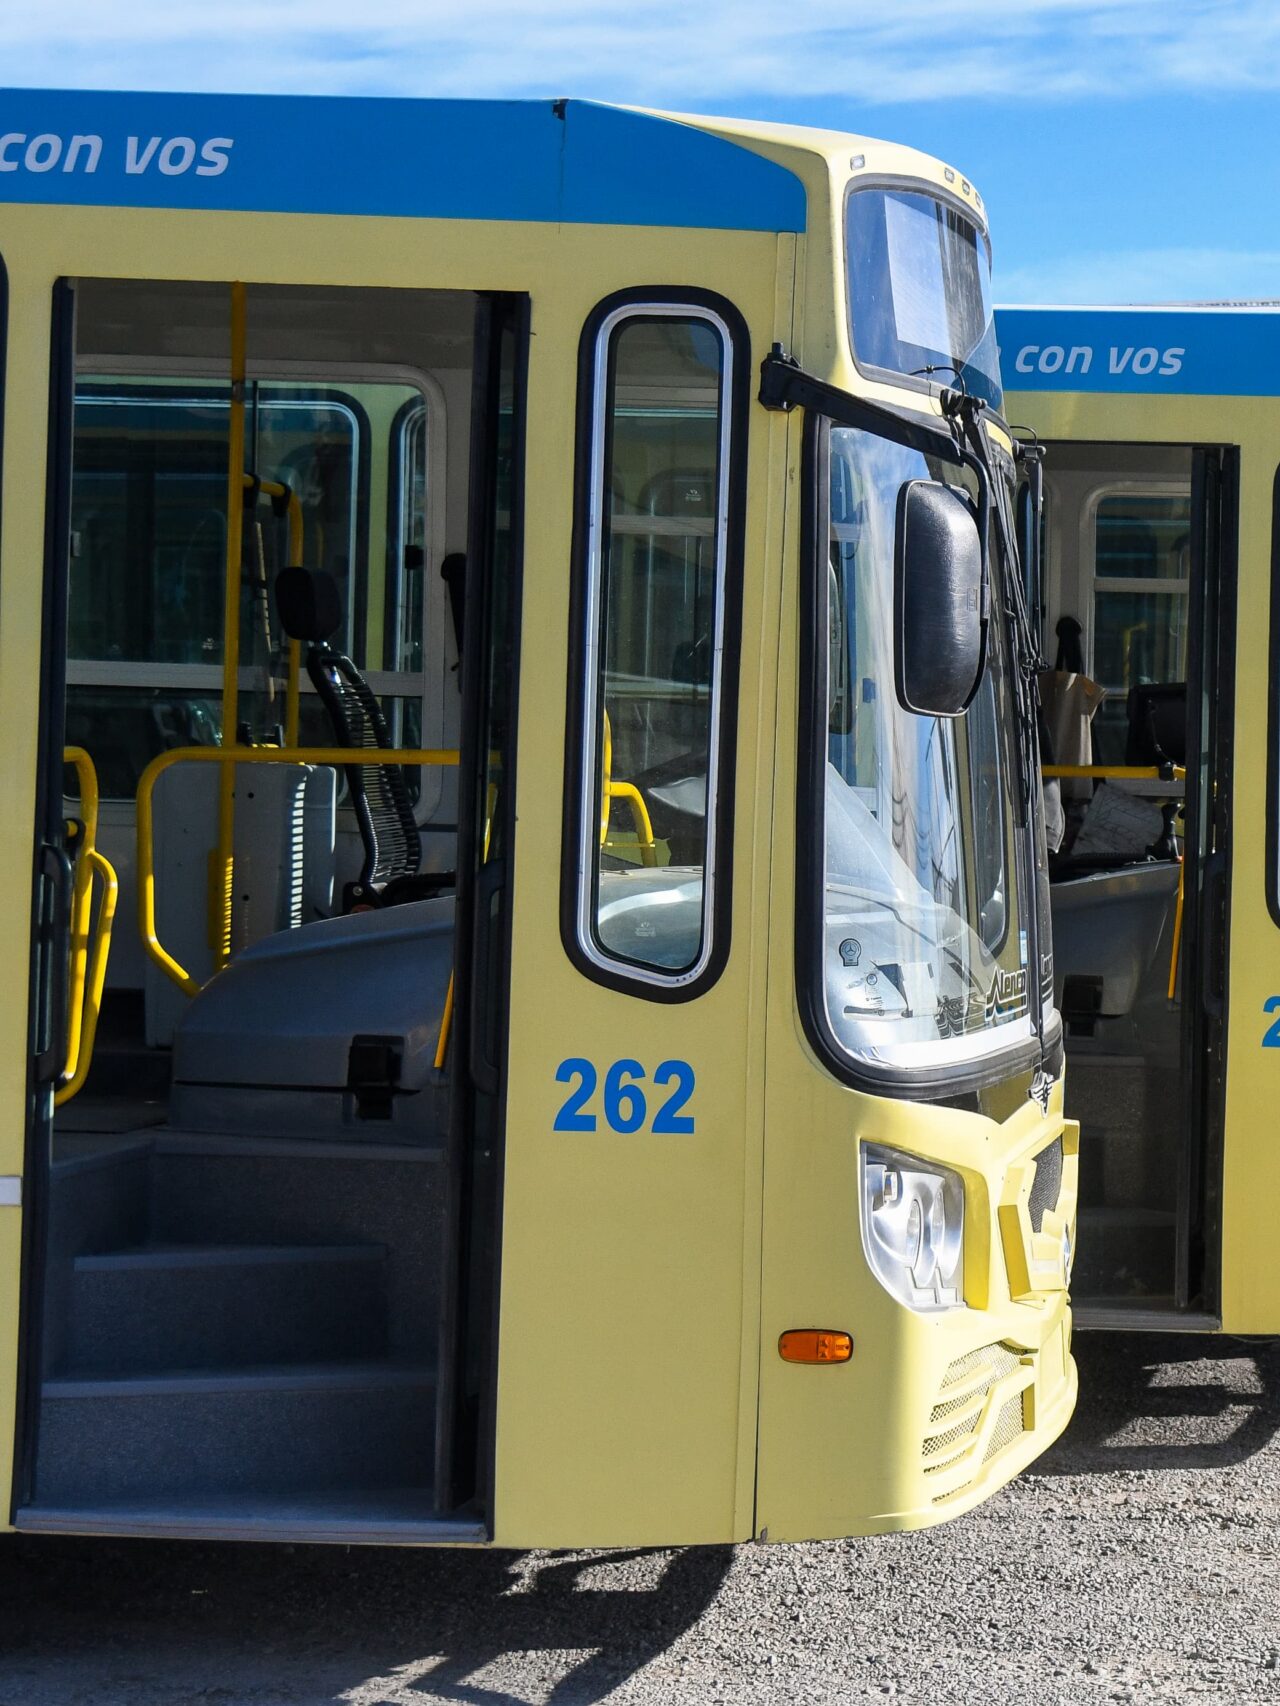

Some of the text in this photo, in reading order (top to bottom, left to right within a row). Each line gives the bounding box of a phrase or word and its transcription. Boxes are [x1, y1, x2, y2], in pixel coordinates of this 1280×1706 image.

[0, 132, 234, 177] con vos
[1015, 345, 1093, 374] con
[1109, 346, 1186, 376] vos
[553, 1057, 696, 1135] 262
